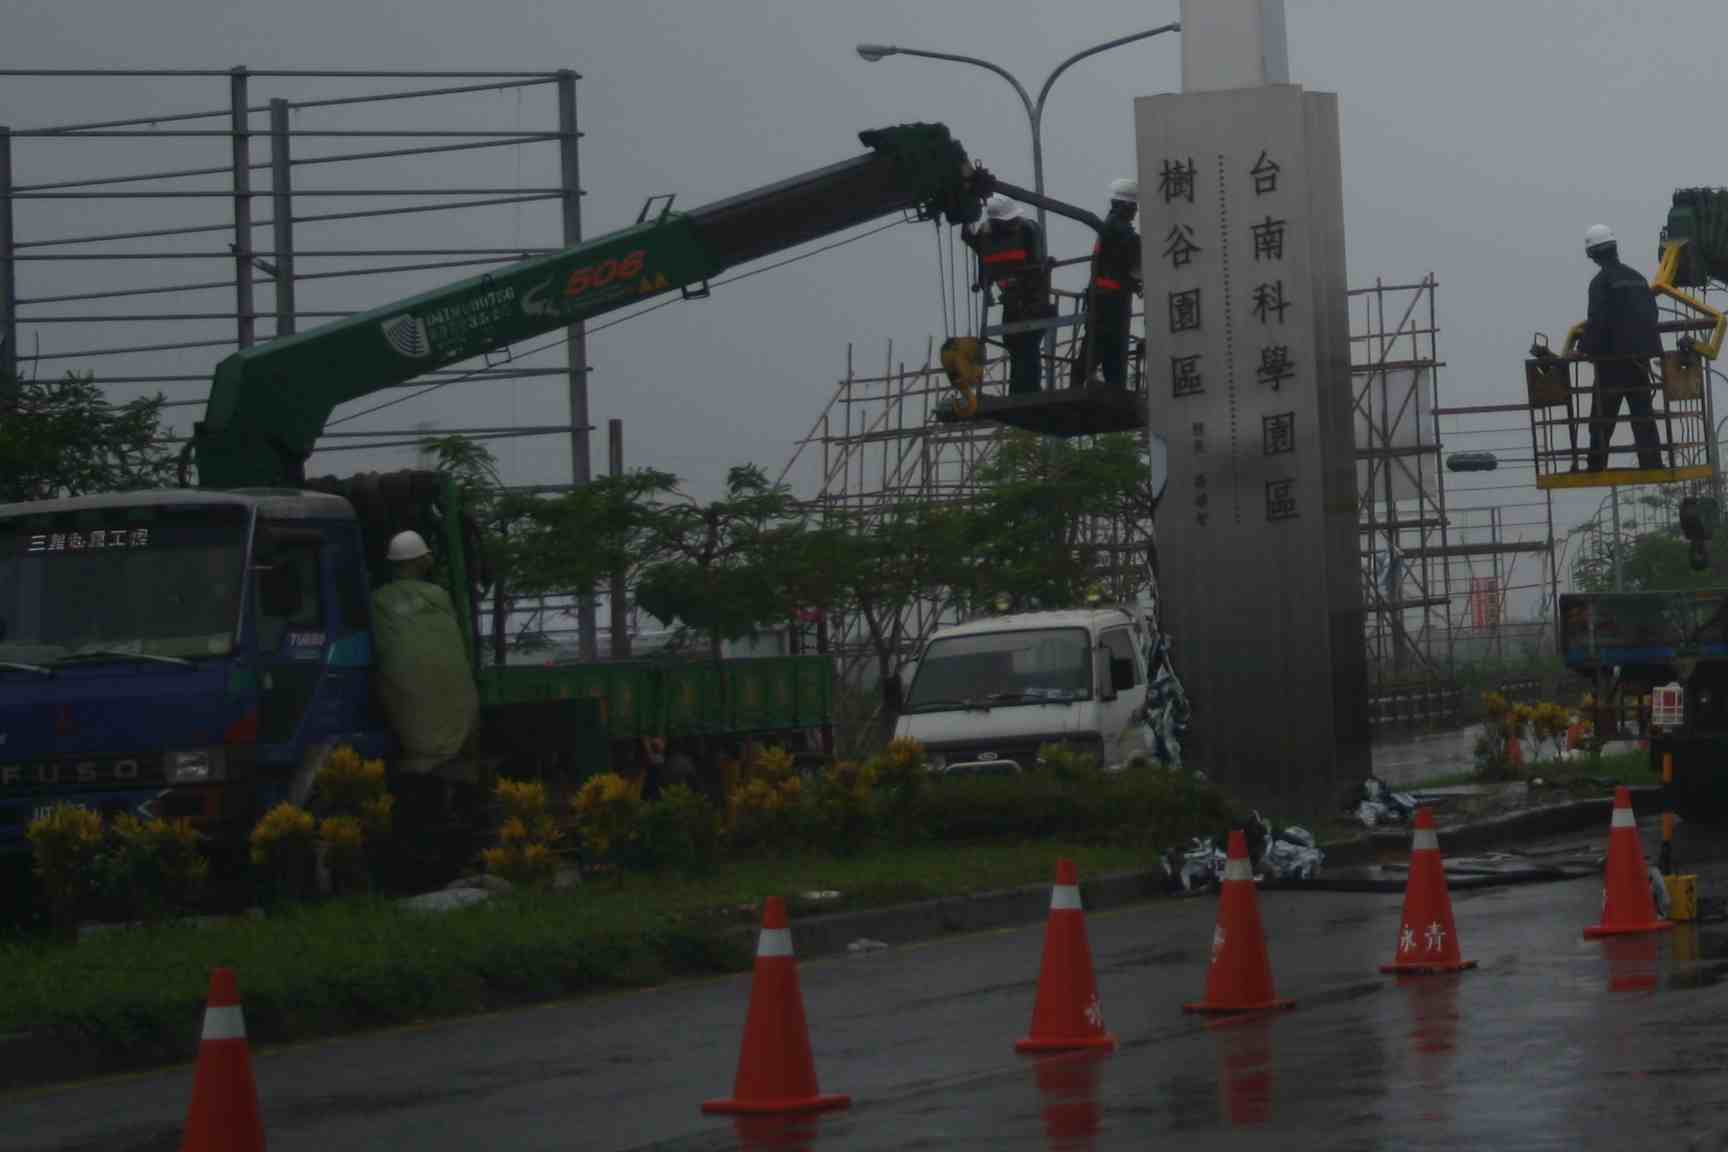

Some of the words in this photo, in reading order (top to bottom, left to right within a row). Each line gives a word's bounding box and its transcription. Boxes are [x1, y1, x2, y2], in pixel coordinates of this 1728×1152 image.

[1158, 156, 1206, 400] 樹谷園區
[1249, 149, 1302, 524] 台南科學園區
[1, 759, 139, 785] FUSO
